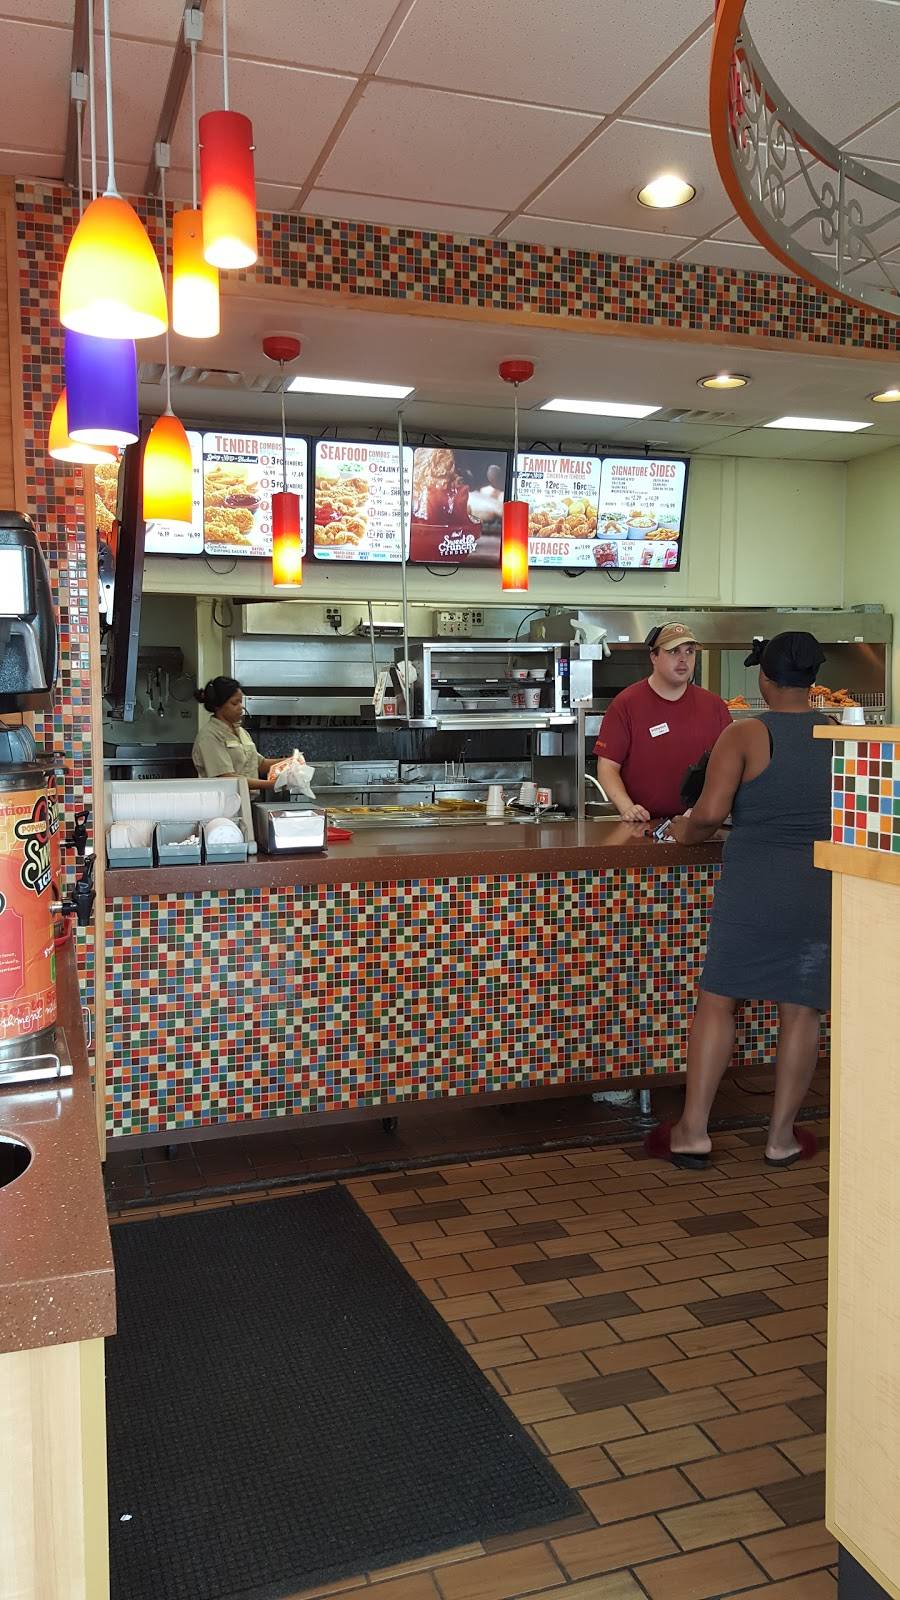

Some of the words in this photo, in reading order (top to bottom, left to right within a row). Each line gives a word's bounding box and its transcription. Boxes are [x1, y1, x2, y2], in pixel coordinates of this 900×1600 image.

[215, 436, 258, 454] TENDER
[260, 442, 282, 450] COMBOS
[320, 444, 368, 462] SEAFOOD
[369, 450, 391, 458] COMBOS
[523, 457, 558, 473] FAMILY
[559, 459, 593, 475] MEALS
[611, 465, 649, 477] SIGNATURE
[649, 463, 677, 478] SIDES
[529, 542, 570, 556] VERAGES
